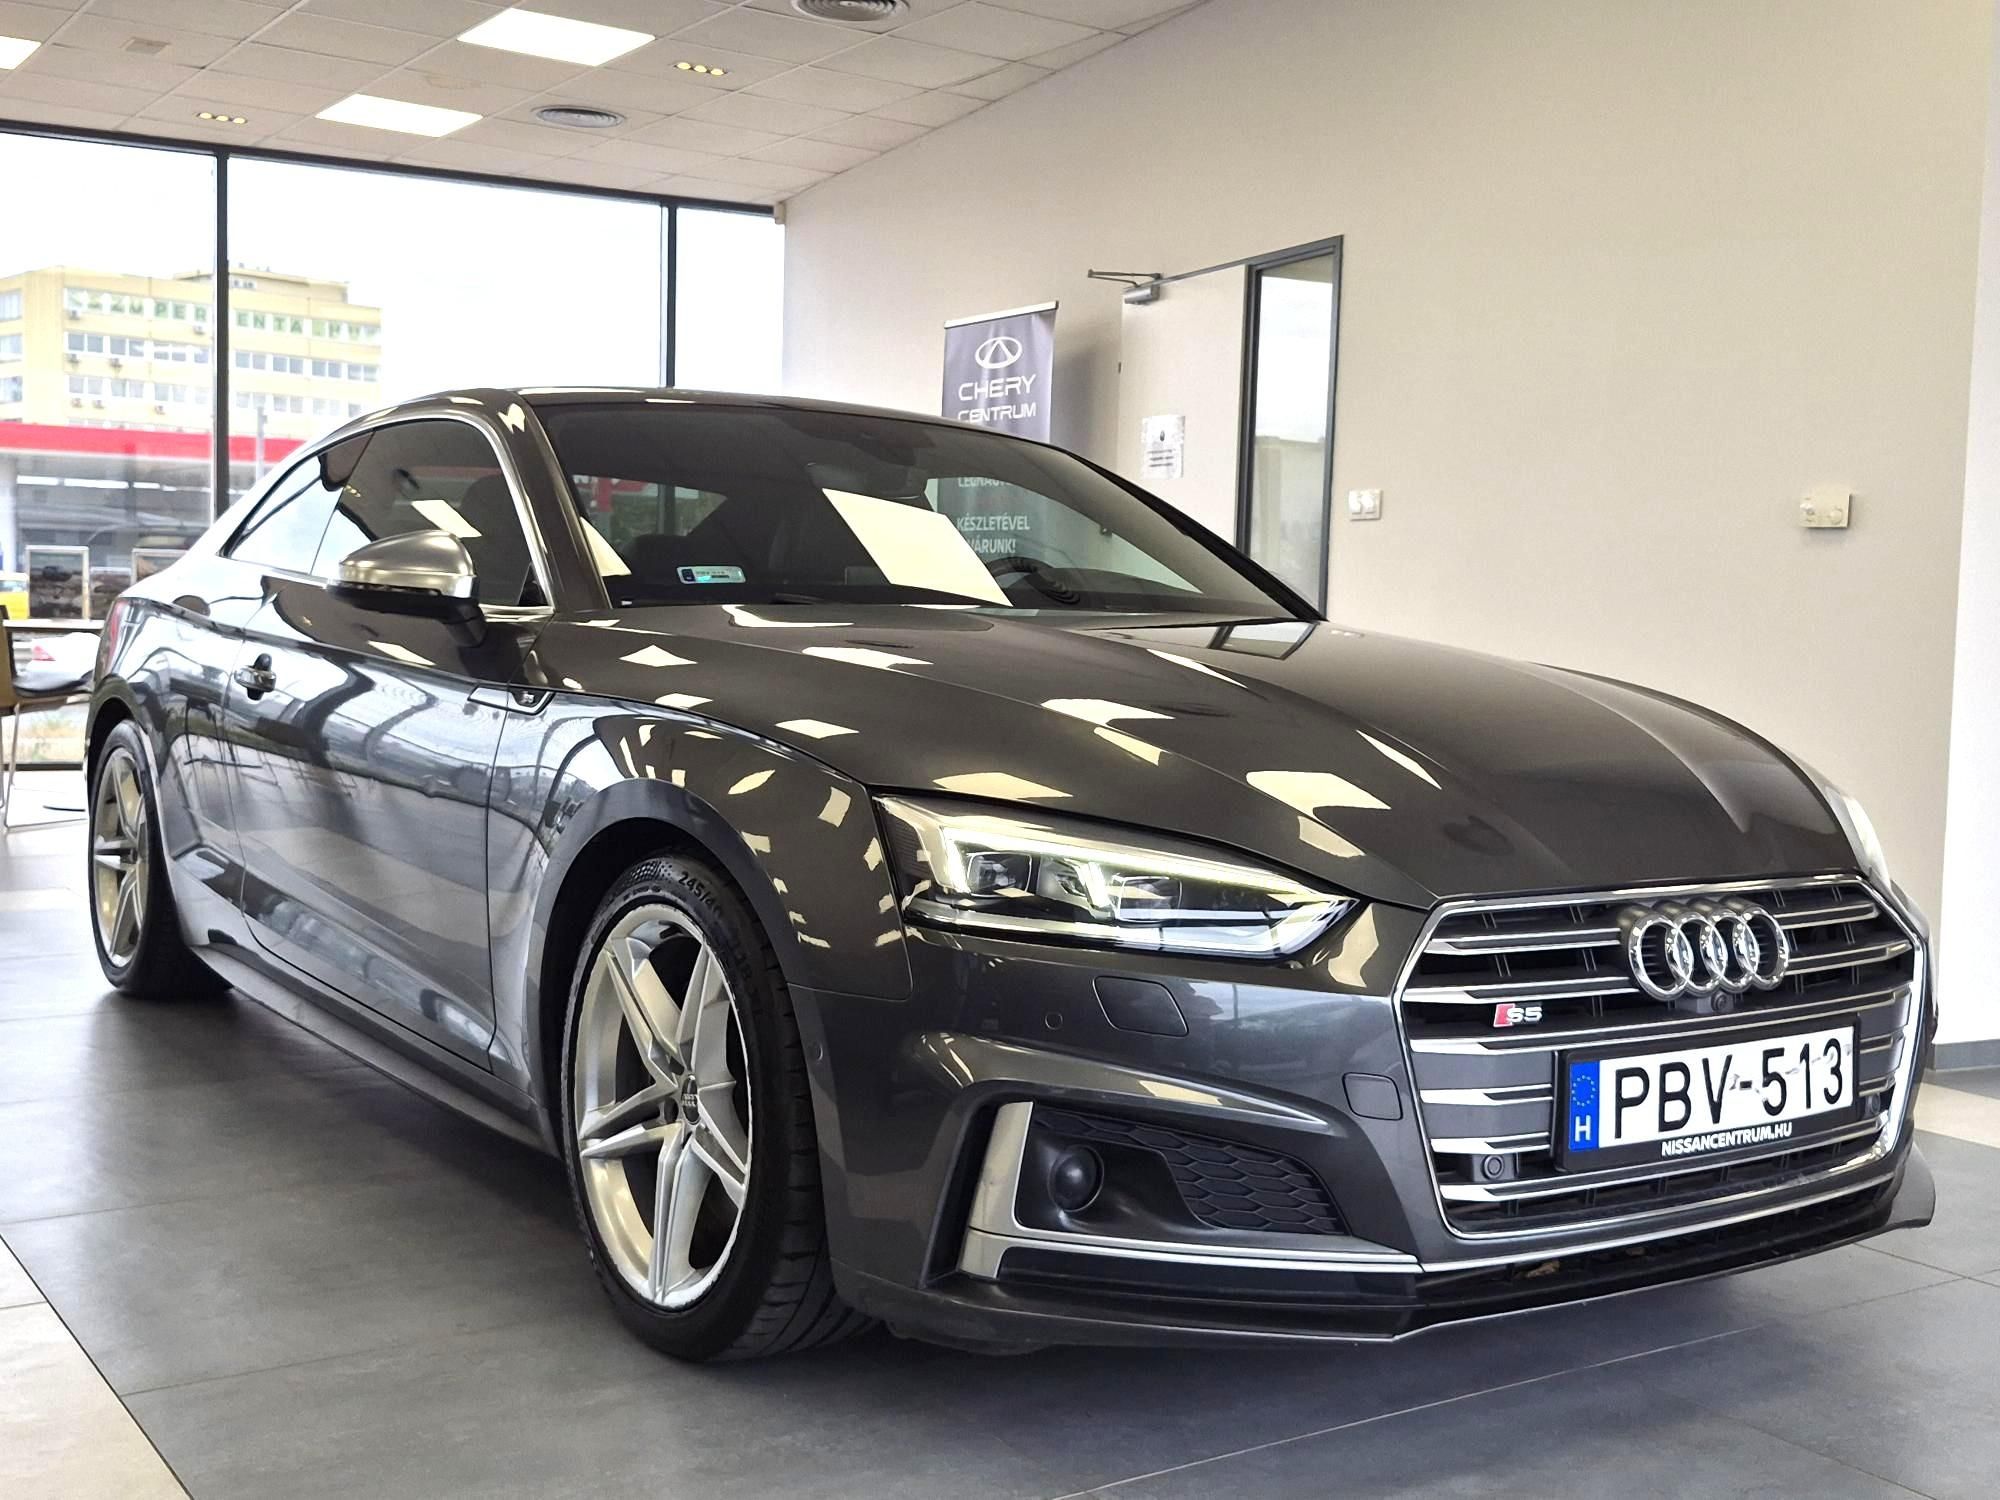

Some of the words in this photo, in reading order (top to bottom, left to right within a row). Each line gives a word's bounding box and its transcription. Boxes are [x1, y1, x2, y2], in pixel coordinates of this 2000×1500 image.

[958, 373, 1037, 401] CHERY
[957, 402, 1037, 423] CENTRUM
[957, 512, 1031, 531] KÉSZLETÉVEL
[1506, 1005, 1543, 1023] S5
[1614, 1037, 1844, 1140] PBV-513
[1574, 1114, 1592, 1142] H
[1660, 1120, 1794, 1157] NISSANCENTRUM.HU
